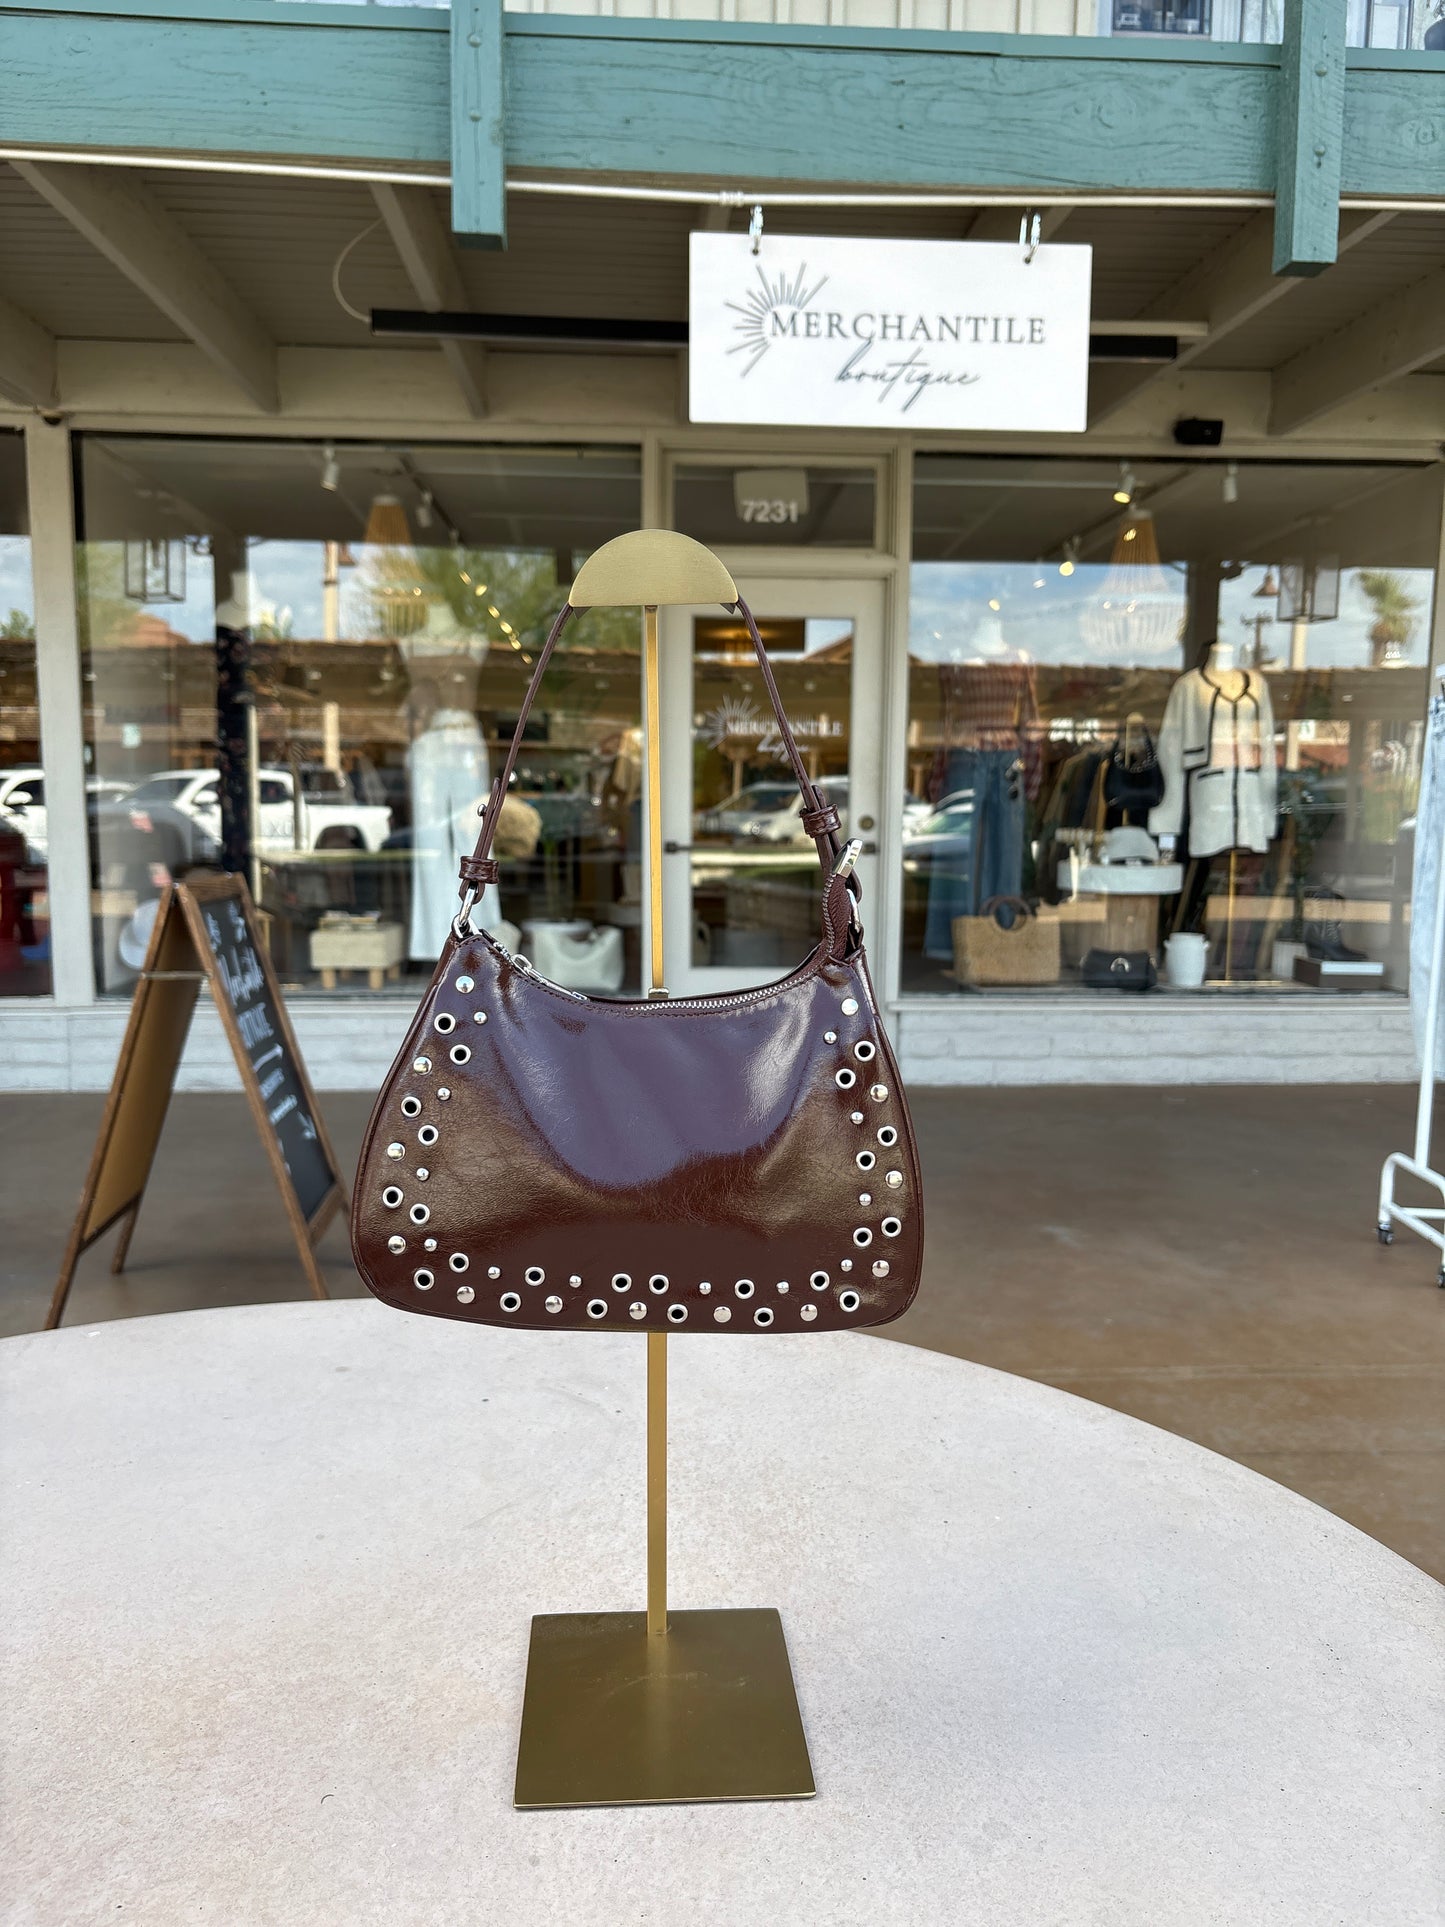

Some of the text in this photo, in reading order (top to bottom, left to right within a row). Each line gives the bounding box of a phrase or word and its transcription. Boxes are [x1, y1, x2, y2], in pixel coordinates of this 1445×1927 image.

[771, 311, 1047, 345] MERCHANTILE
[834, 339, 980, 412] boutique
[741, 500, 799, 523] 7231
